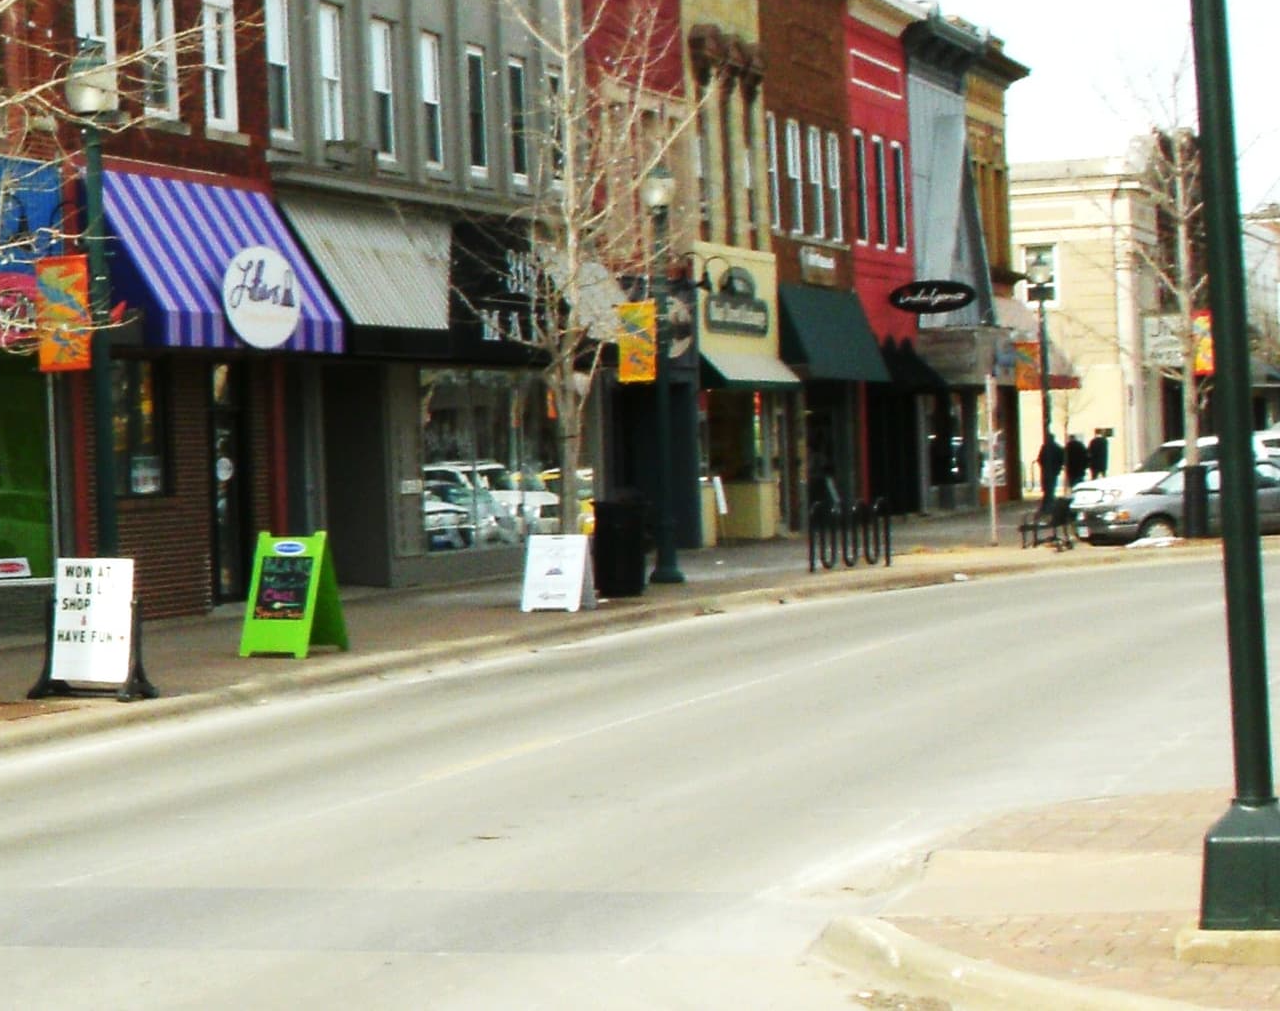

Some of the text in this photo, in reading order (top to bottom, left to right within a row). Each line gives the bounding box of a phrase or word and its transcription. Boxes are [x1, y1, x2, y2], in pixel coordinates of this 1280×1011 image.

[65, 565, 92, 578] WOW
[62, 597, 91, 611] SHOP
[57, 630, 86, 643] HAVE
